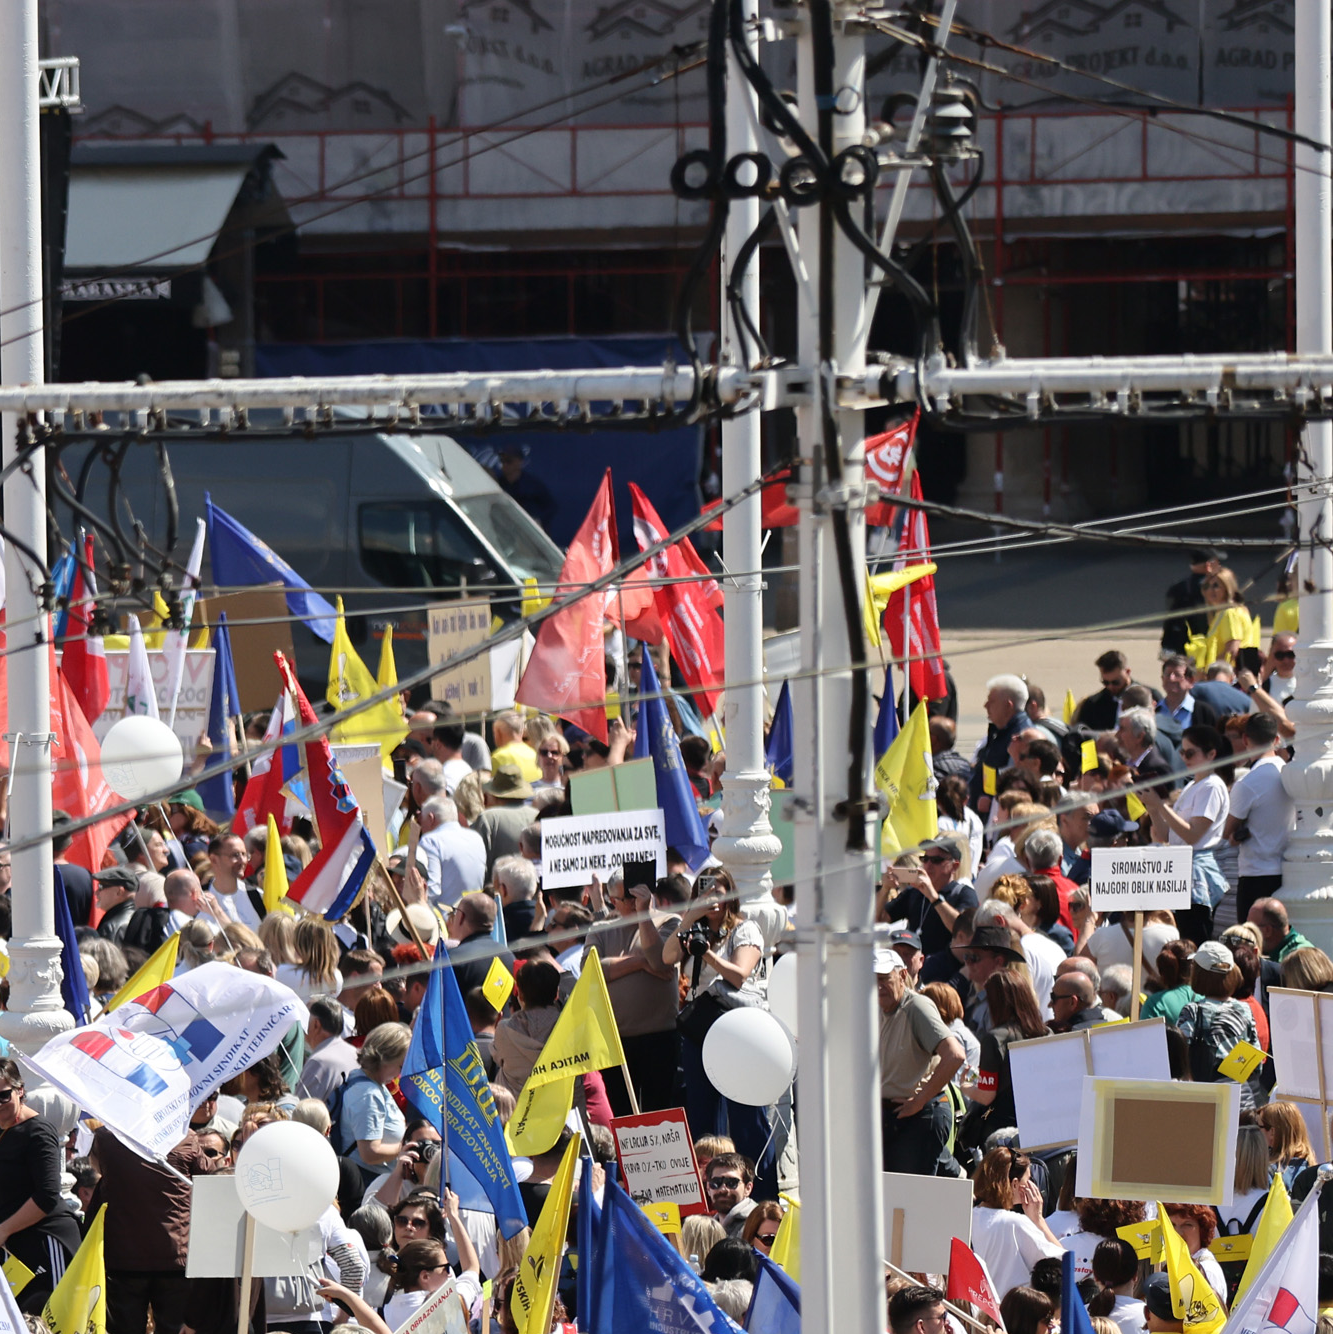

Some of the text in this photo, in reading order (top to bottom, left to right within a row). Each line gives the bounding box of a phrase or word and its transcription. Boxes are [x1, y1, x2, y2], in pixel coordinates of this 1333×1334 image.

[545, 825, 662, 850] MOGUĆNOST NAPREDOVANJA ZA SVE,
[554, 858, 562, 872] NE
[562, 857, 580, 872] SAMO
[581, 855, 588, 870] ZA
[589, 854, 607, 869] NEKE
[1111, 858, 1174, 875] SIROMAŠTVO JE
[1095, 879, 1187, 895] NAJGORI OBLIK NASILJA
[213, 1027, 250, 1077] SINDIKAT
[438, 1105, 498, 1183] OBRAZOVANJA
[620, 1134, 650, 1151] INFLACIJA
[662, 1128, 681, 1145] NAŠA
[477, 1128, 512, 1190] ZNANOSTI
[655, 1180, 699, 1198] MATEMATIKU?
[410, 1286, 454, 1333] OBRAZOVANJA
